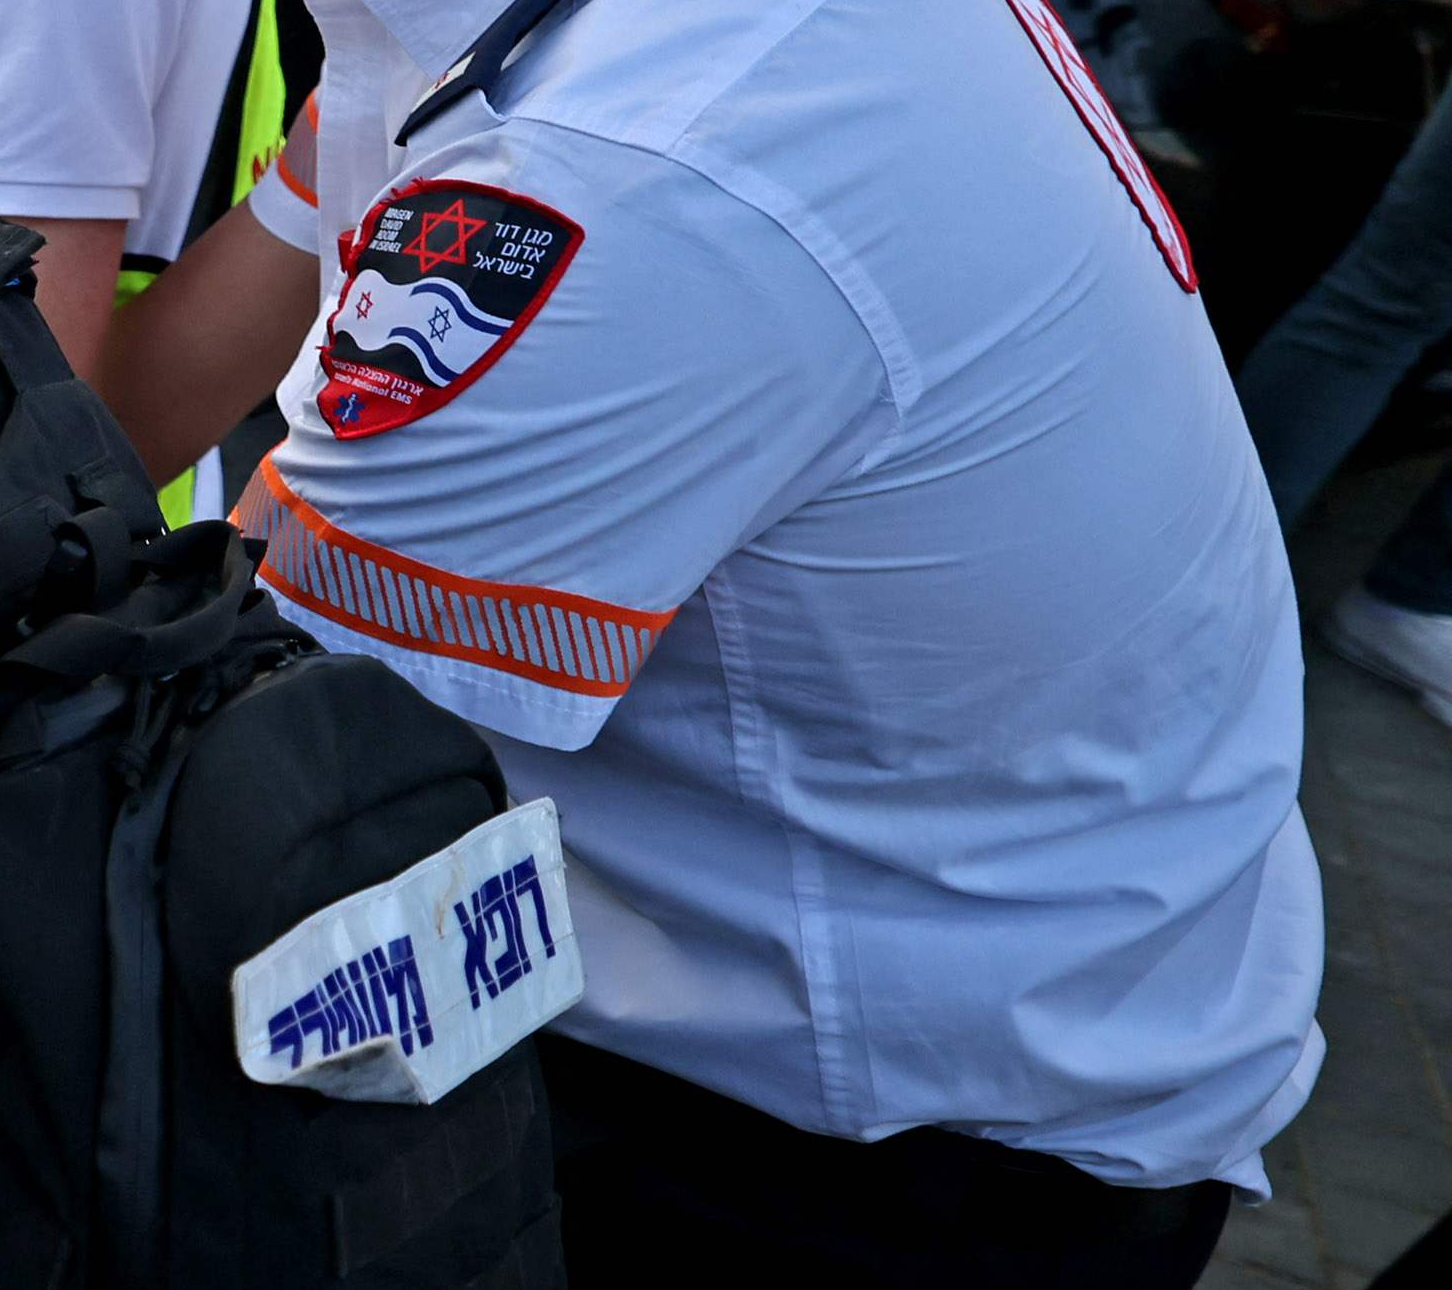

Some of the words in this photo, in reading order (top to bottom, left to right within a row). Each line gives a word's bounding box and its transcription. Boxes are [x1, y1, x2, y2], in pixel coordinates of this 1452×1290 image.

[495, 222, 522, 240] דוד
[522, 228, 553, 247] מגן
[501, 242, 546, 263] אדום
[472, 251, 535, 280] בישראל
[390, 390, 413, 405] EMS
[453, 854, 556, 1010] רופא
